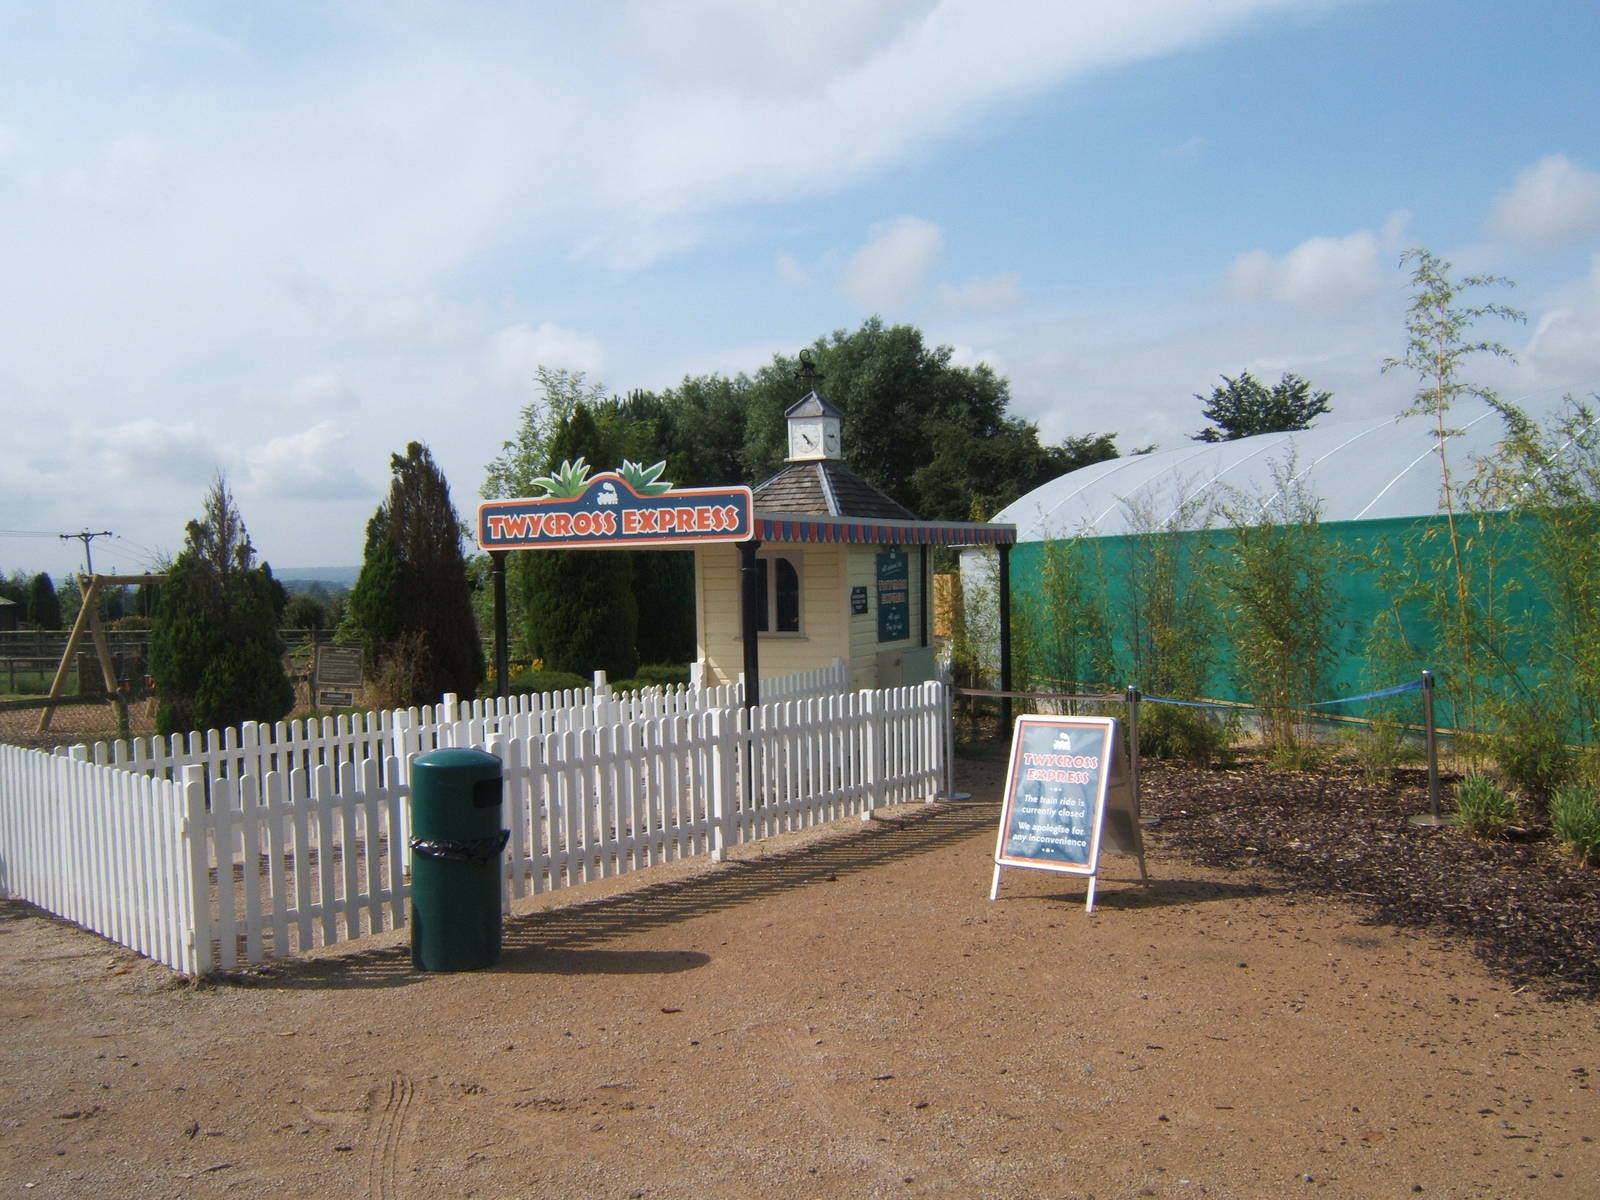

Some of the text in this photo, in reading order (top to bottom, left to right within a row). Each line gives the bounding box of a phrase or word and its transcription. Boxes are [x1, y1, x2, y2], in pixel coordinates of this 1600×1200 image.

[488, 505, 739, 538] TWYCROSS EXPRESS
[1023, 753, 1098, 769] TWYCROSS
[1027, 768, 1089, 785] EXPRESS
[1024, 794, 1085, 807] The train ride is
[1021, 806, 1085, 818] currently closed
[1018, 821, 1084, 835] We apologise for
[1012, 833, 1087, 847] any inconvenience
